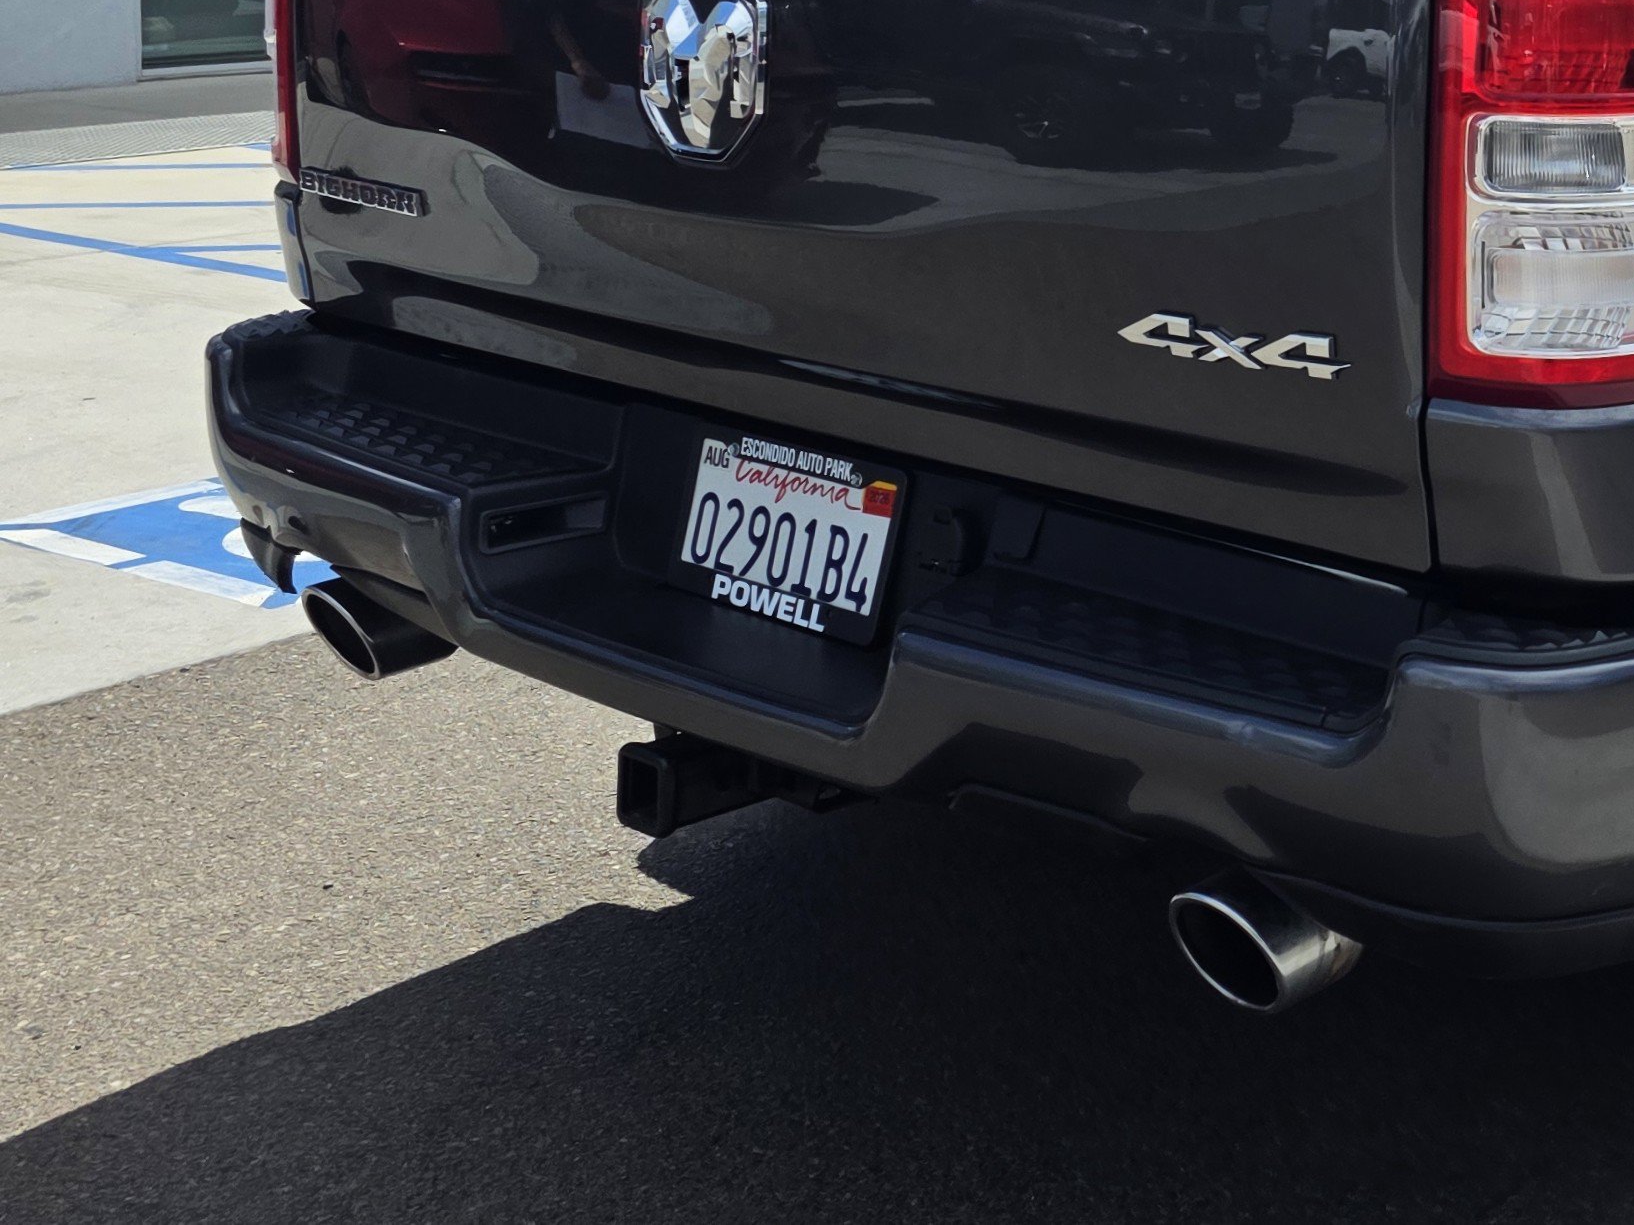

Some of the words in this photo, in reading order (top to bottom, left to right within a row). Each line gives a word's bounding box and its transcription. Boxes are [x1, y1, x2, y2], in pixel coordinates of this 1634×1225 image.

[704, 445, 730, 469] AUG
[740, 437, 796, 467] ESCONDIDO
[796, 451, 823, 473] AUTO
[824, 457, 853, 482] PARK
[736, 458, 862, 510] California
[690, 491, 869, 613] 02901B4
[711, 573, 825, 633] POWELL
